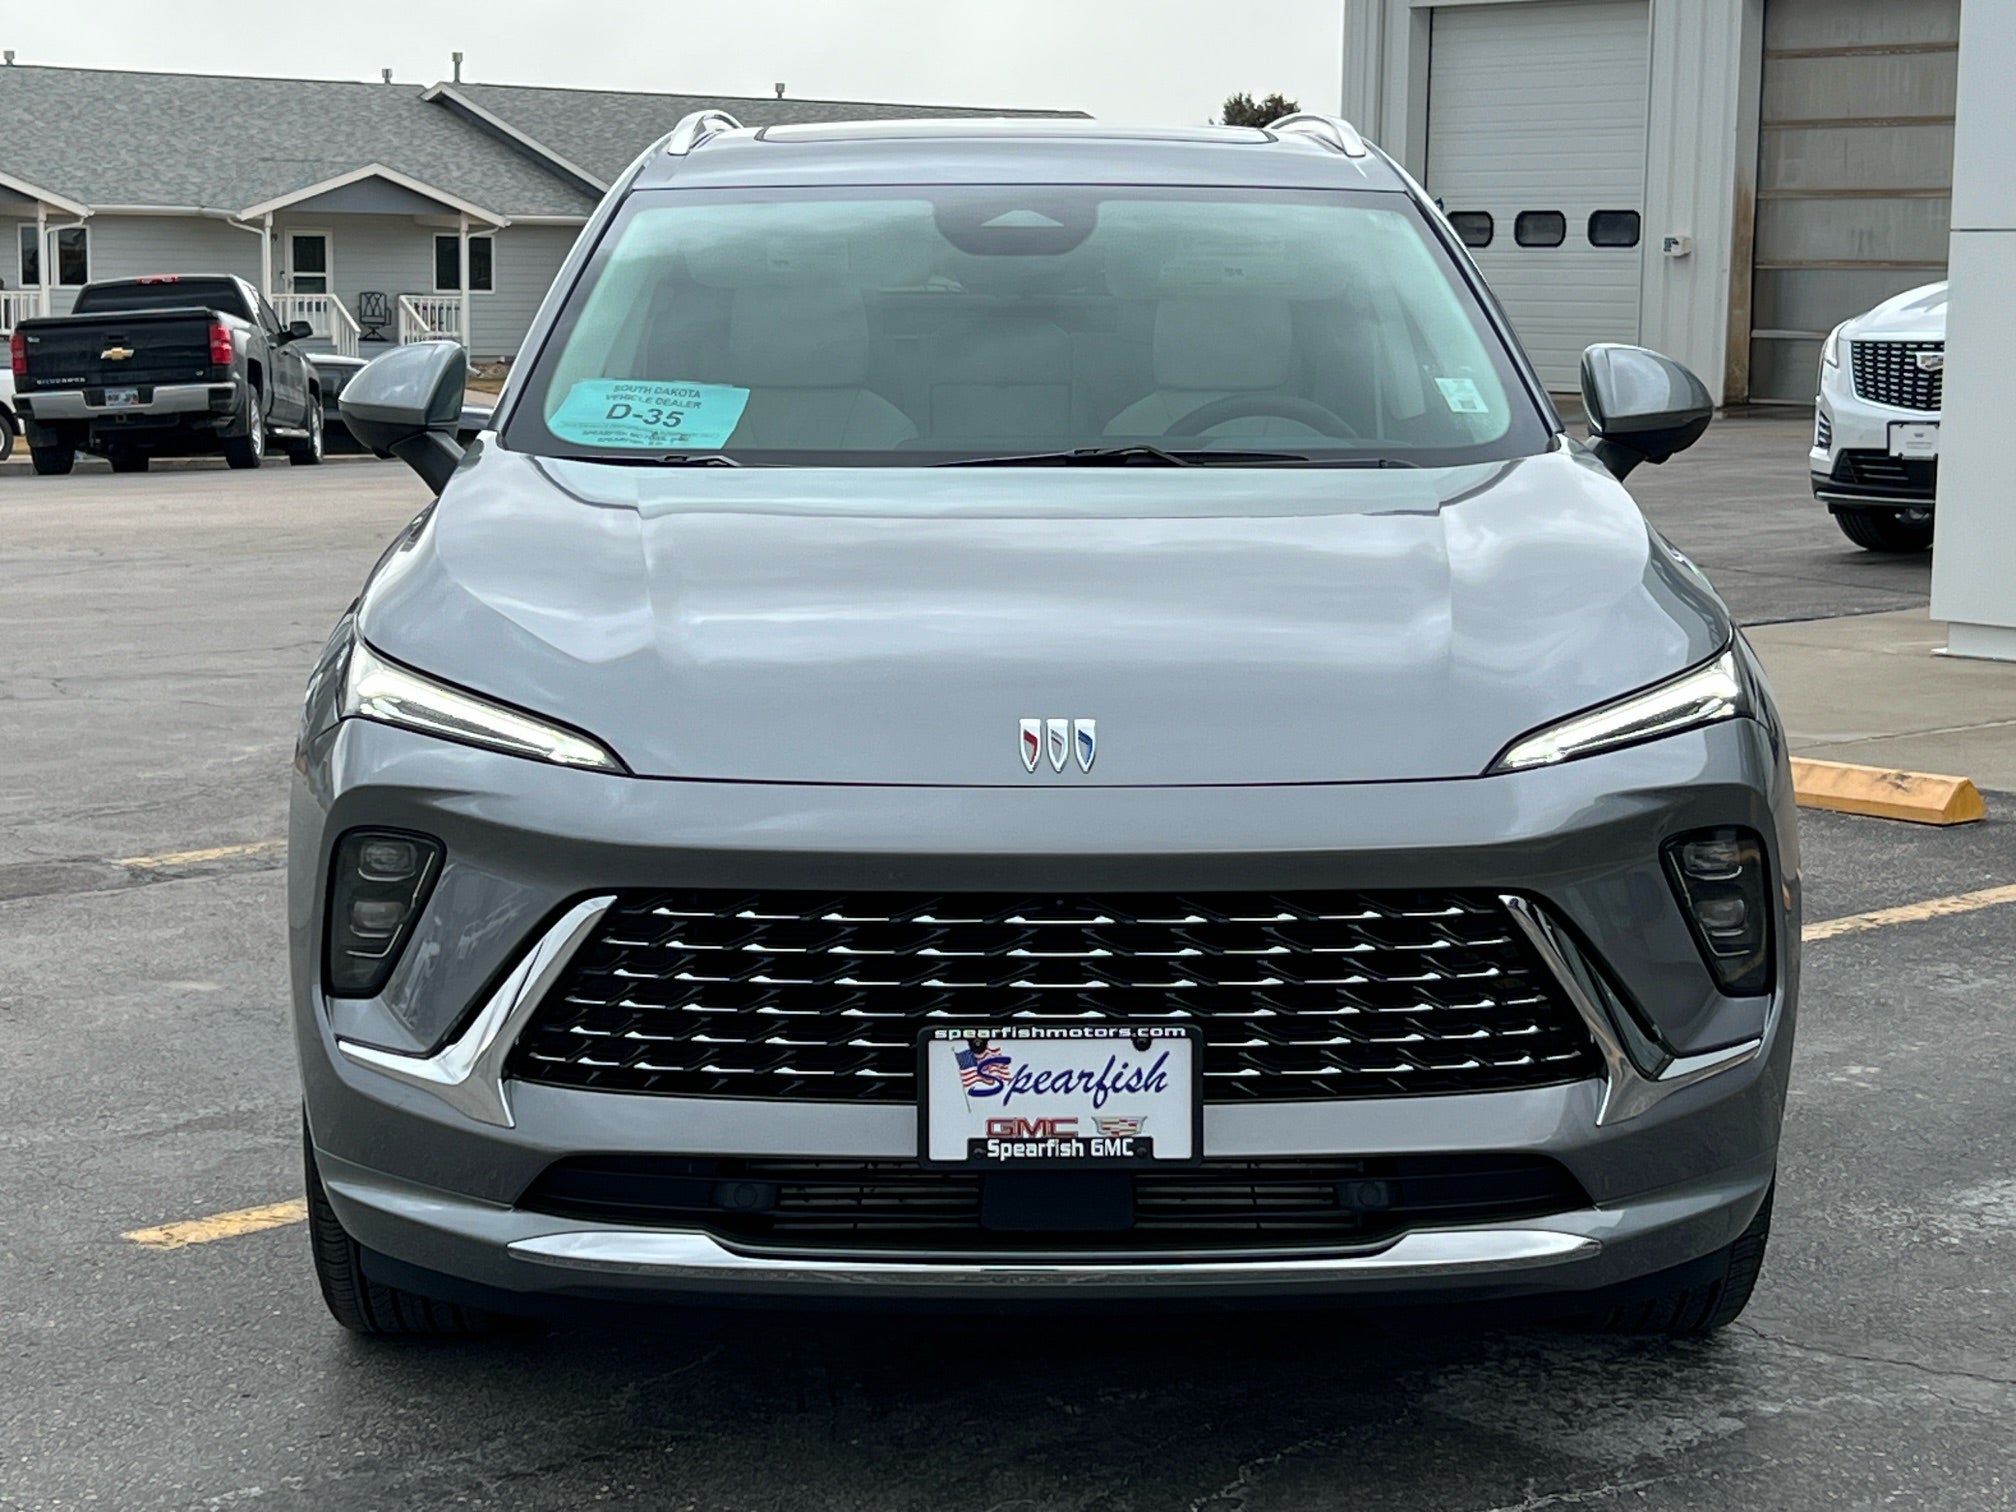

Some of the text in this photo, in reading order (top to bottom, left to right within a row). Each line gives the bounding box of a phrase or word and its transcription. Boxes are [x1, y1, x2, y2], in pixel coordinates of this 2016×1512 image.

[613, 385, 701, 398] SOUTH DAKOTA
[655, 397, 702, 409] DEALER
[606, 403, 685, 428] D-35
[934, 1027, 1186, 1041] spearfishmotors.com
[967, 1051, 1170, 1109] Spearfish
[986, 1117, 1079, 1138] GMC
[987, 1138, 1134, 1162] Spearfish GMC
